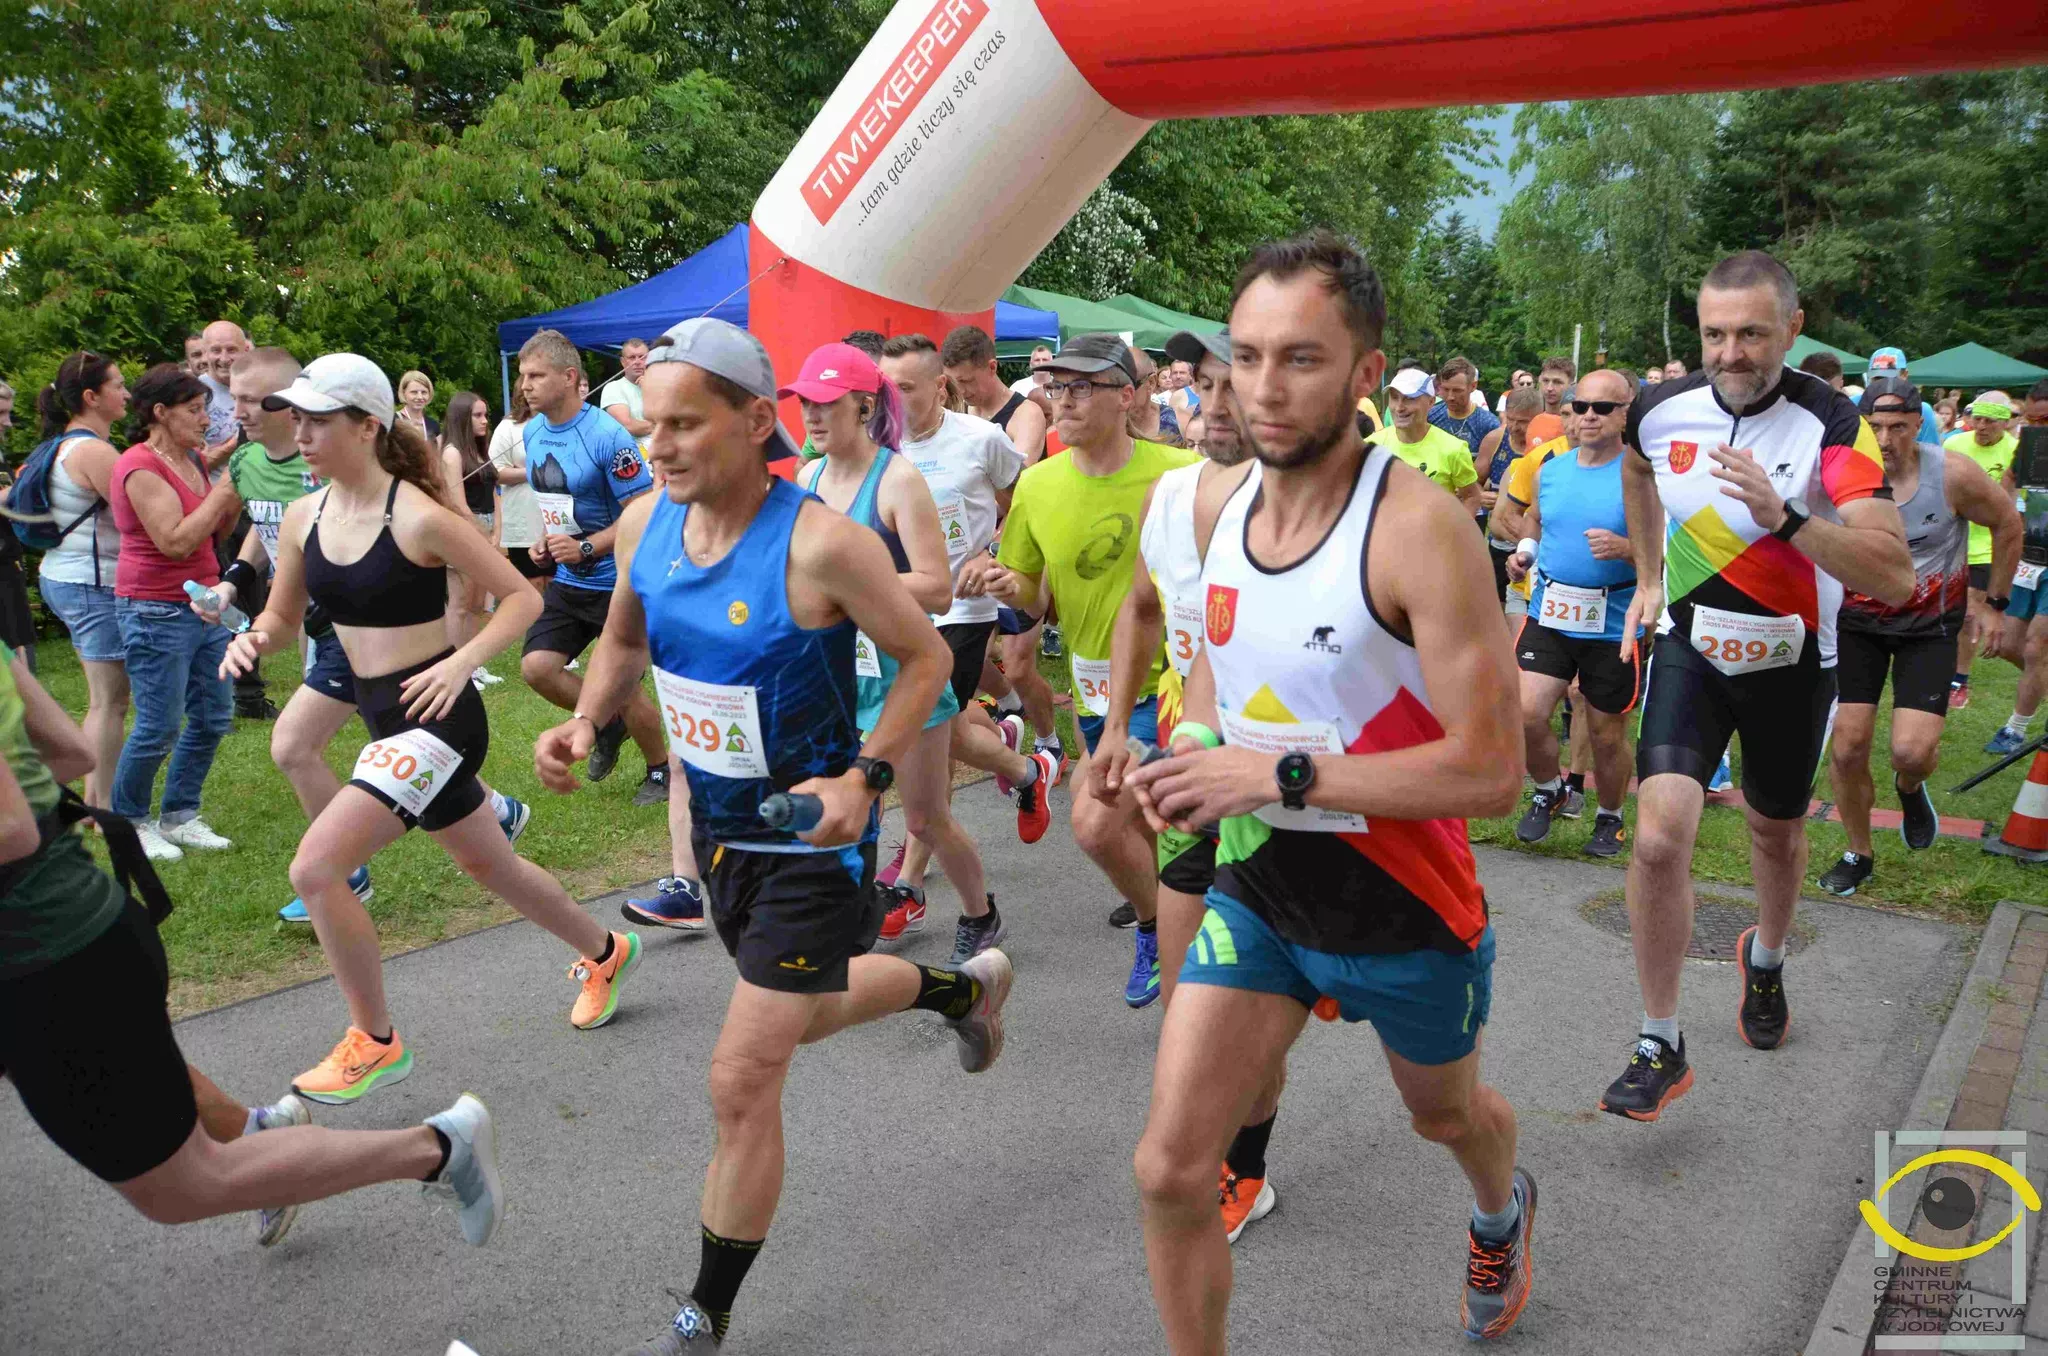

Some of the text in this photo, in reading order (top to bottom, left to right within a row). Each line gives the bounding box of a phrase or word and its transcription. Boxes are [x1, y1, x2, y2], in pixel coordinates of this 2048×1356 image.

[812, 0, 975, 201] TIMEKEEPER
[887, 137, 923, 185] gdzie
[917, 96, 955, 140] liczy
[952, 69, 977, 99] się
[973, 30, 1006, 71] czas
[1544, 599, 1582, 622] 321
[1700, 635, 1768, 663] 289
[666, 704, 721, 752] 329
[360, 743, 417, 781] 350
